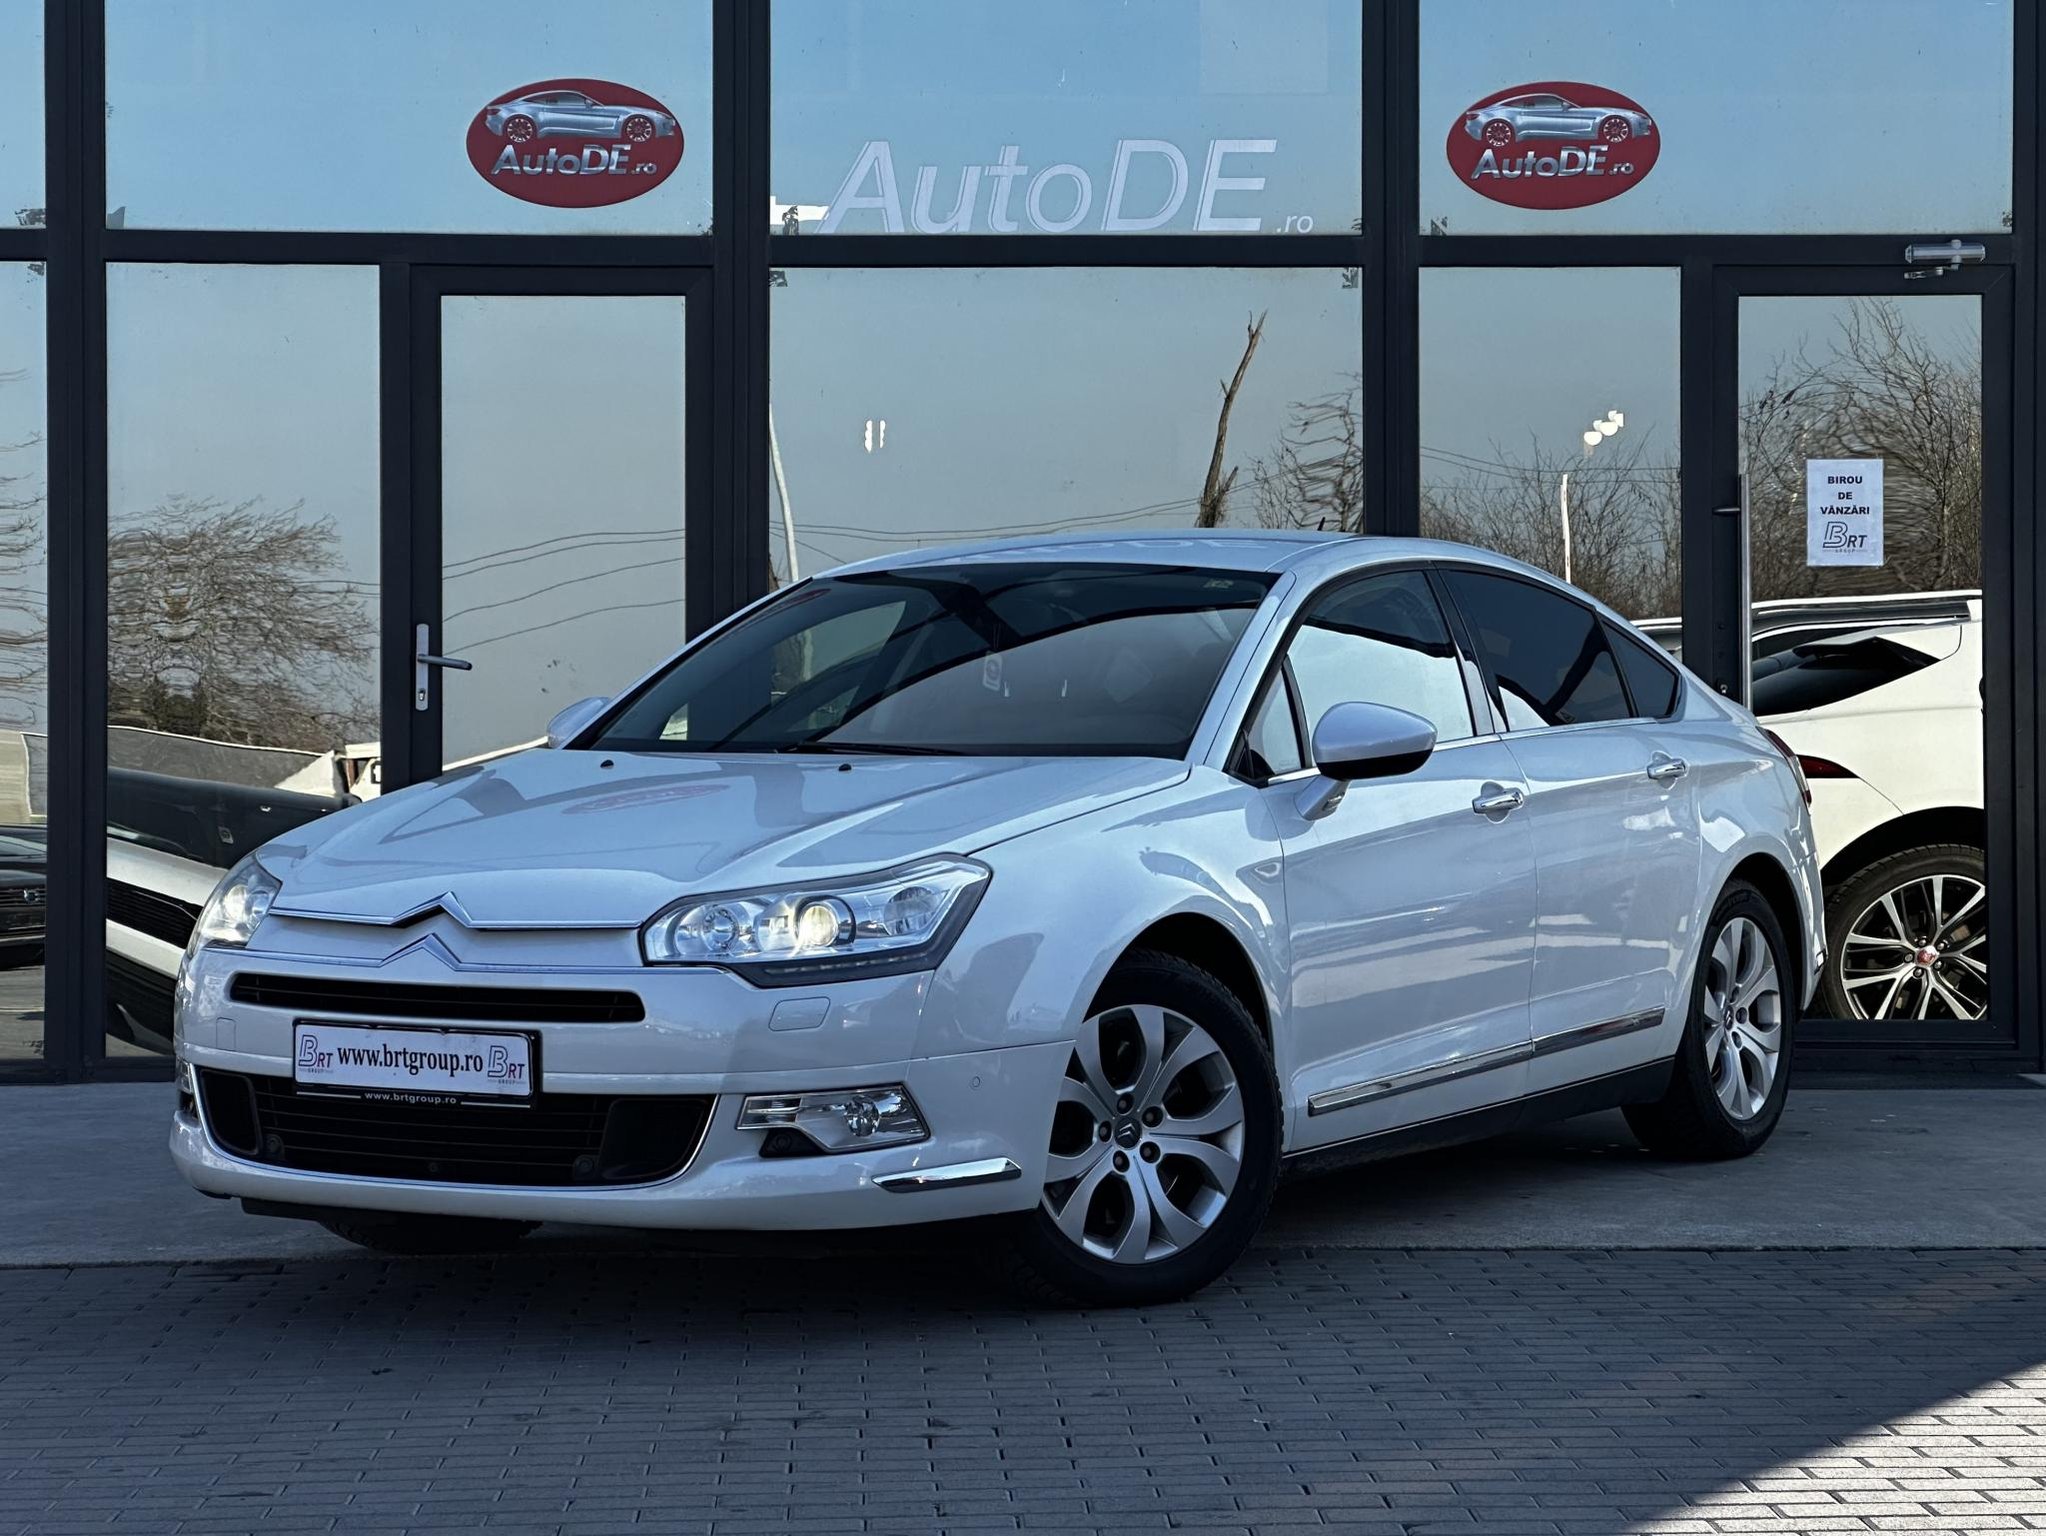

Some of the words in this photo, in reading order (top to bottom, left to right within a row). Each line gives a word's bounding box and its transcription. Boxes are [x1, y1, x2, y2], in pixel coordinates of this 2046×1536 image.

[1828, 476, 1862, 484] BIROU
[1838, 492, 1852, 500] DE
[1822, 521, 1867, 549] BRT
[298, 1034, 333, 1067] BRT
[337, 1043, 483, 1077] www.brtgroup.ro
[487, 1045, 525, 1079] BRT
[364, 1092, 457, 1105] www.brtgroup.ro
